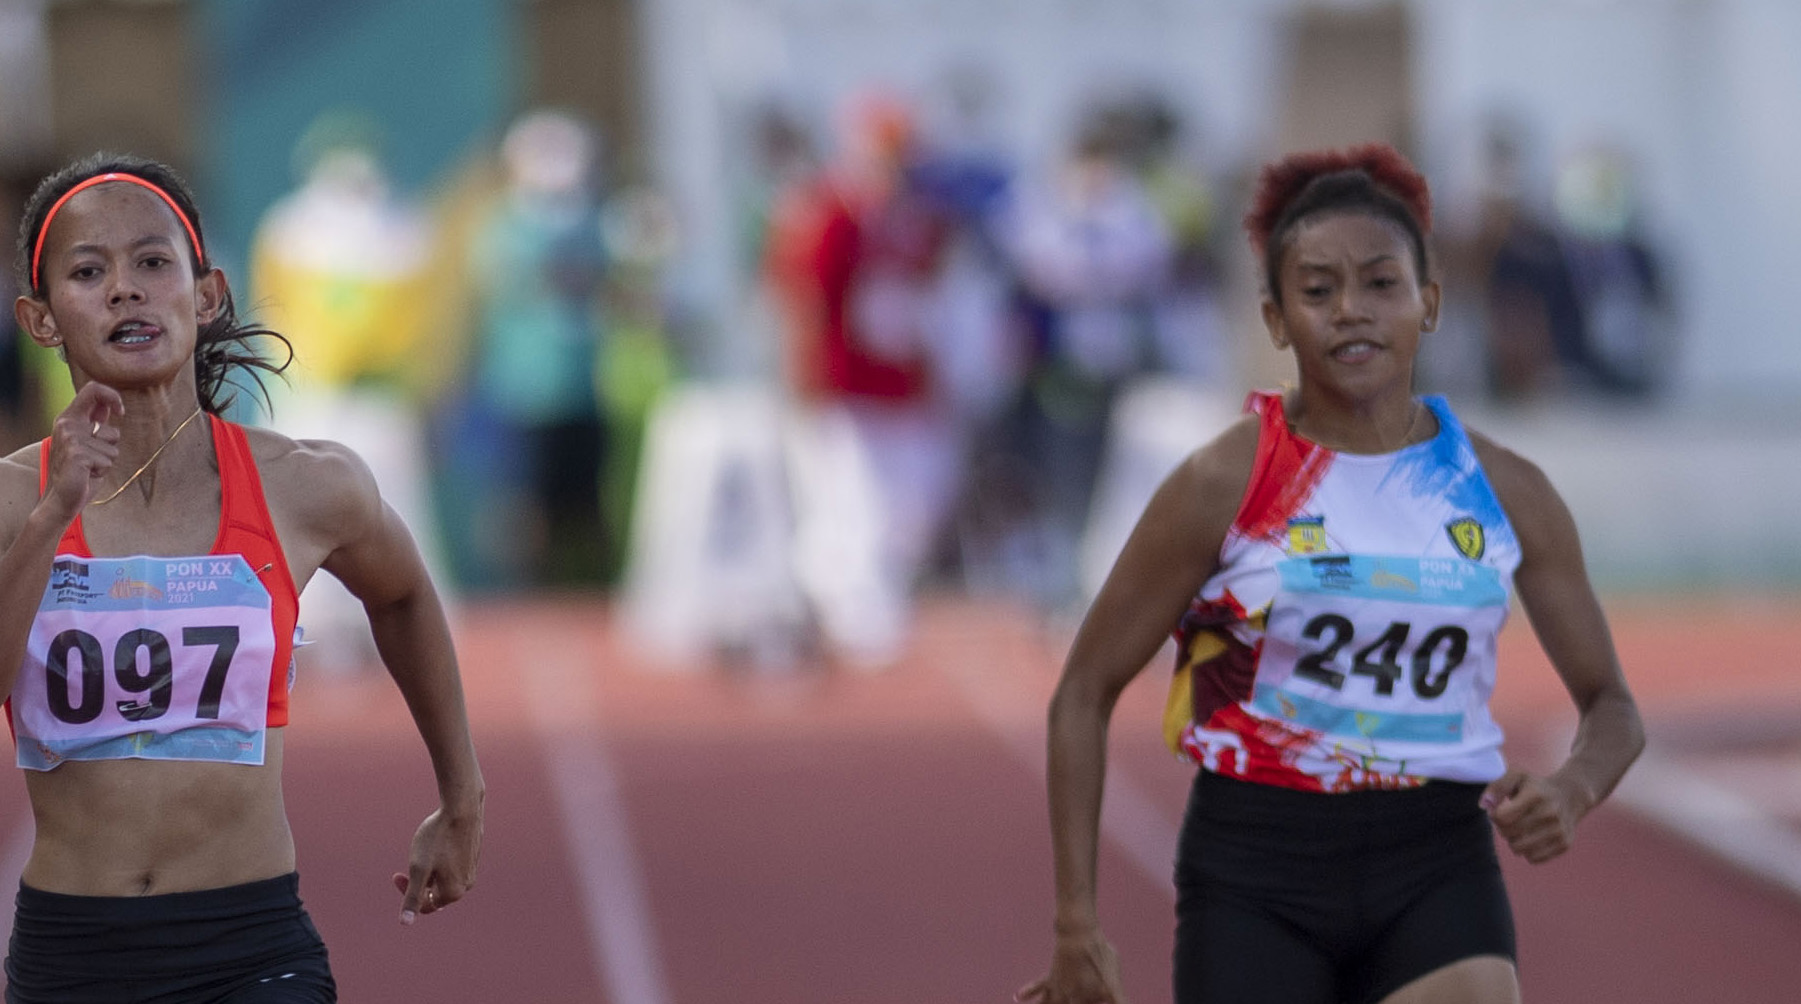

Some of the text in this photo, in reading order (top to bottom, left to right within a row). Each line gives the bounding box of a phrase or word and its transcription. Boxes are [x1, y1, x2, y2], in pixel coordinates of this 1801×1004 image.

[166, 562, 233, 577] PON XX
[167, 580, 218, 592] PAPUA
[168, 592, 194, 604] 2021
[1293, 614, 1468, 699] 240
[46, 626, 240, 724] 097
